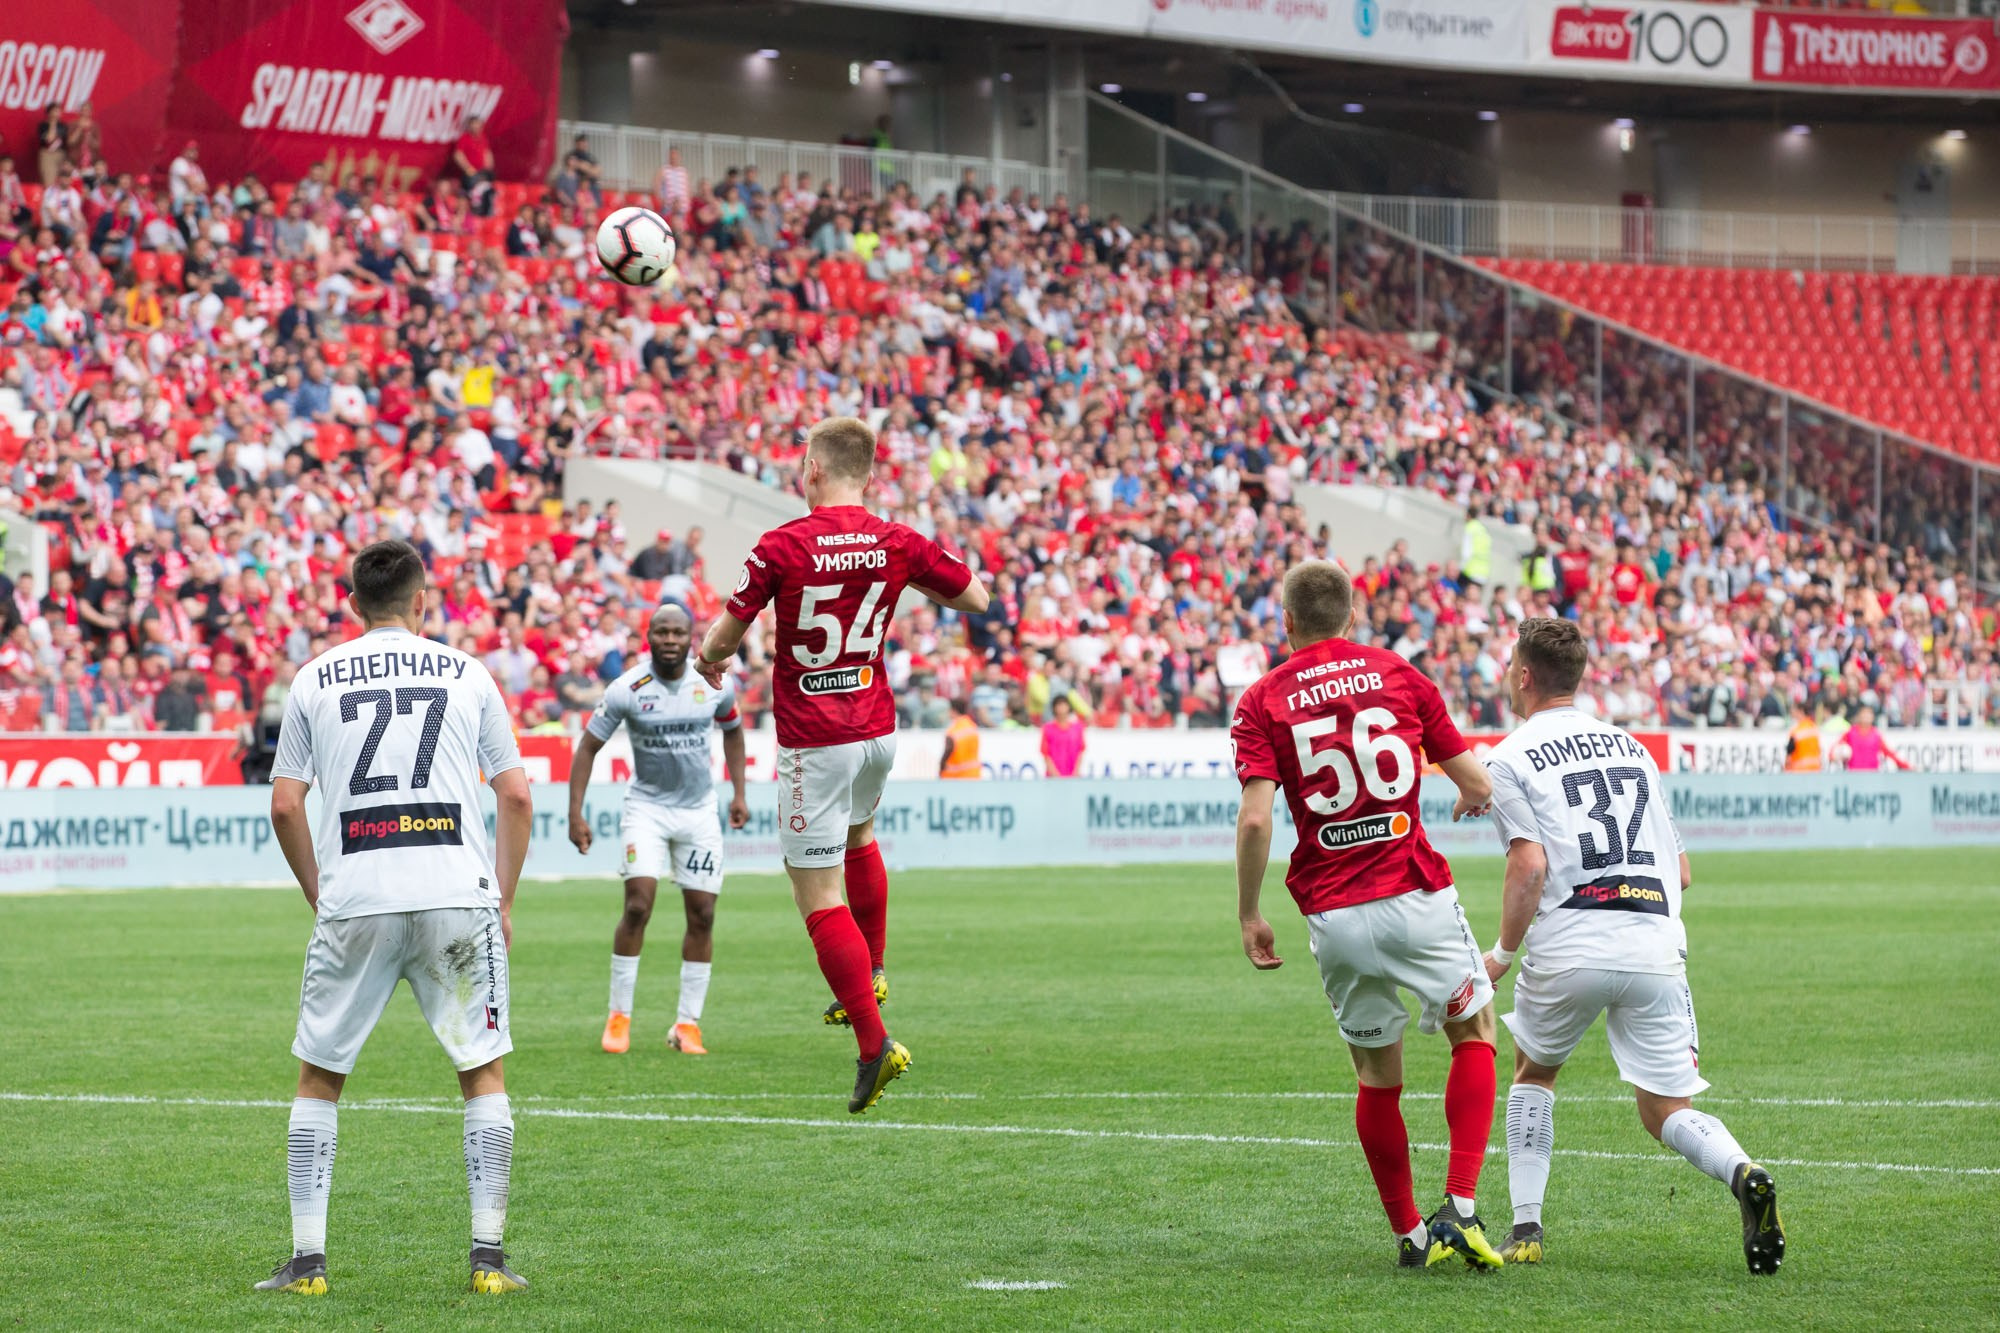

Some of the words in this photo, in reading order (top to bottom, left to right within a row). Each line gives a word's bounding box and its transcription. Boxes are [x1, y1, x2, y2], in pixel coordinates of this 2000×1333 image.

[1559, 21, 1625, 49] ЭКТО
[1623, 11, 1729, 67] 100
[816, 533, 878, 546] NISSAN
[812, 549, 887, 573] УМЯРОВ
[791, 581, 889, 668] 54
[317, 652, 466, 690] НЕДЕЛЧАРУ
[808, 674, 857, 690] Winline
[1296, 658, 1367, 682] NISSAN
[1287, 672, 1384, 711] ГАПОНОВ
[340, 686, 448, 796] 27
[1525, 733, 1645, 773] ВОМБЕРГА
[1291, 706, 1416, 816] 56
[349, 815, 455, 839] BingoBoom
[1327, 821, 1386, 843] Winline
[1562, 766, 1656, 870] 32
[686, 849, 715, 877] 44
[1579, 883, 1664, 903] ngoBoom
